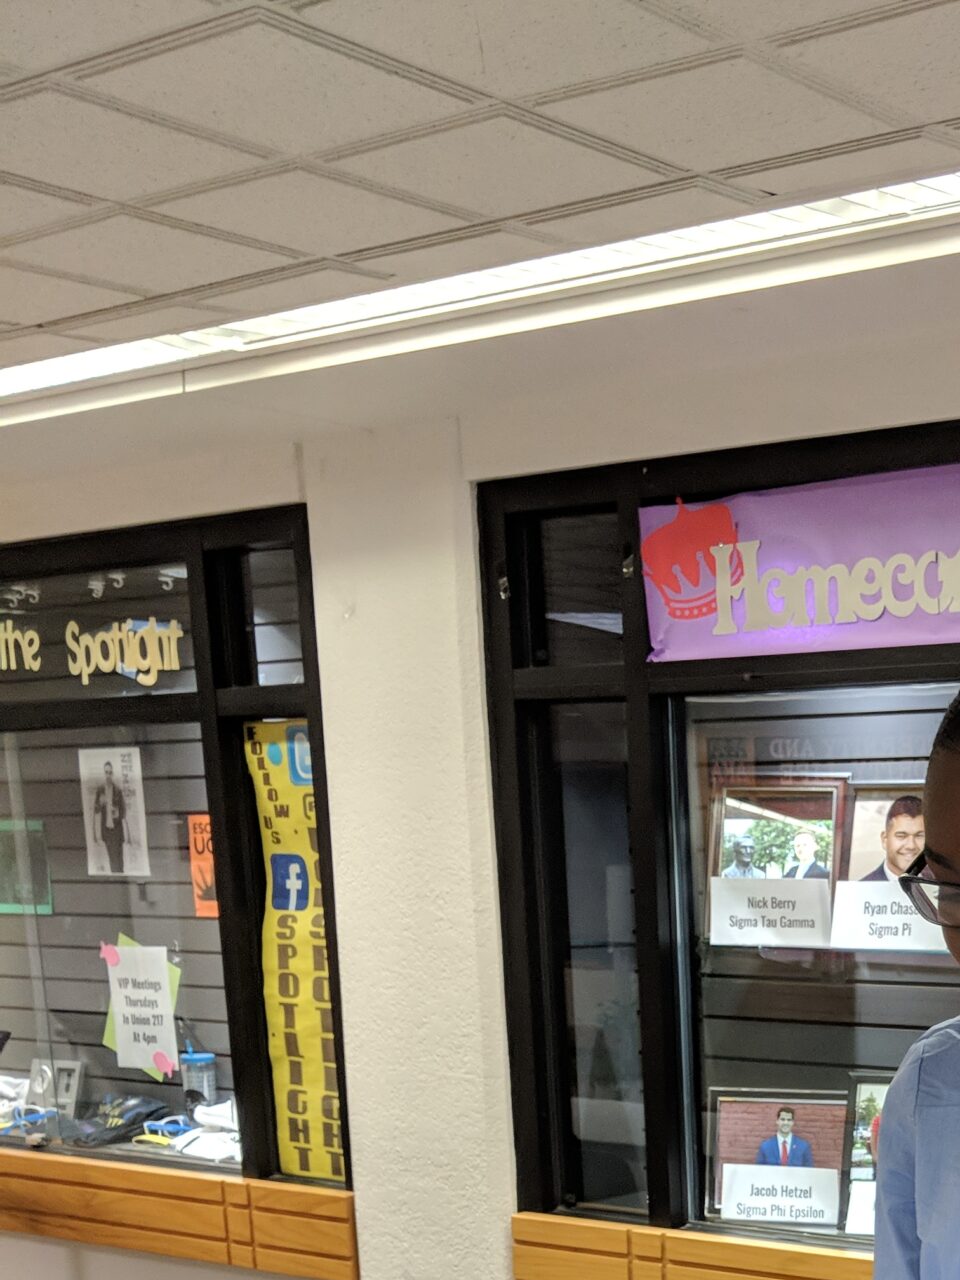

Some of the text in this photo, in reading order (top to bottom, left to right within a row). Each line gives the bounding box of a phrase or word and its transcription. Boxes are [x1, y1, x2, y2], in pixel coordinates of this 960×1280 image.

[0, 616, 184, 687] the Spotlight
[246, 726, 289, 845] FOLLOW US
[747, 896, 796, 911] Nick Berry
[863, 901, 887, 917] Ryan
[729, 915, 815, 930] Sigma Tau Gamma
[868, 922, 912, 939] Sigma Pi
[117, 977, 162, 993] VIP Meetings
[124, 995, 159, 1010] Thursdays
[122, 1013, 164, 1027] In Union 217
[133, 1031, 141, 1044] At
[275, 914, 313, 1172] SPOTLIGHT
[749, 1183, 812, 1199] Jacob Hetzel
[736, 1202, 825, 1220] Sigma Phi Epsilon
